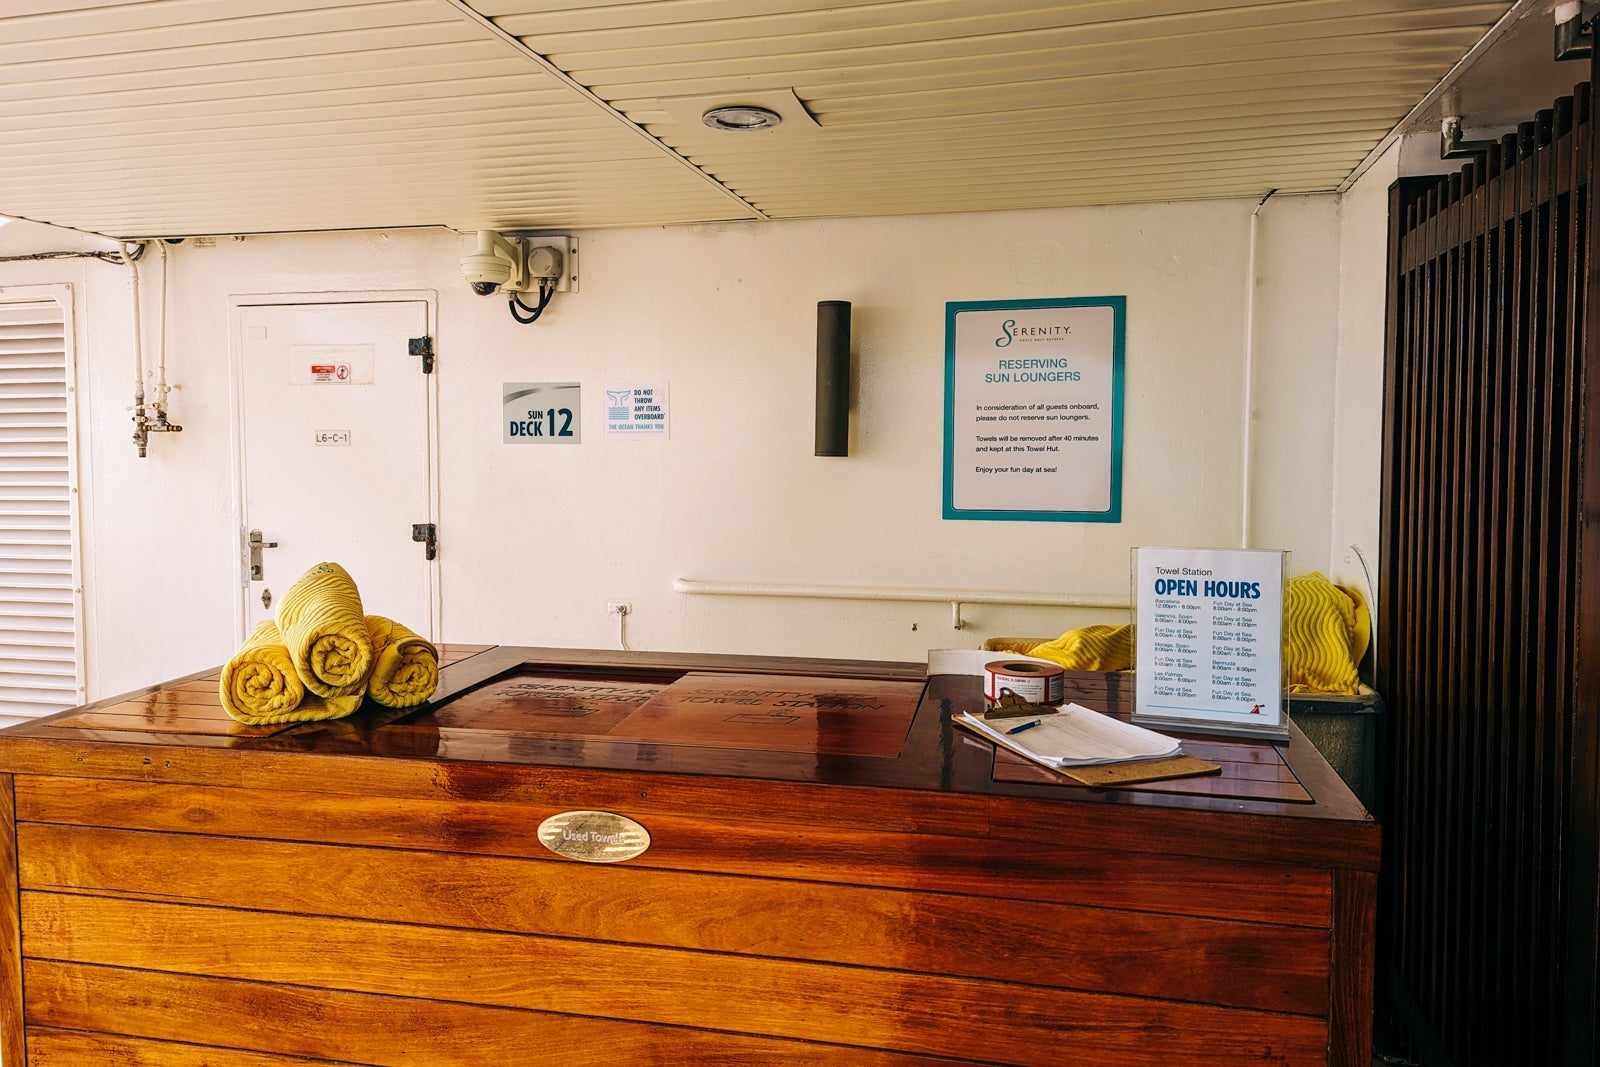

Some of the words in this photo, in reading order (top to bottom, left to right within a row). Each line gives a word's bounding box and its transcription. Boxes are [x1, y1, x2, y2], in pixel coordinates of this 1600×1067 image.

[995, 320, 1070, 347] SERENITY
[999, 358, 1067, 369] RESERVING
[986, 373, 1009, 383] SUN
[1014, 372, 1080, 382] LOUNGERS
[528, 410, 543, 419] SUN
[510, 421, 543, 436] DECK
[547, 408, 573, 436] 12
[316, 434, 346, 442] L6-C-1
[1182, 568, 1212, 576] Station
[1155, 579, 1197, 596] OPEN
[1204, 581, 1260, 599] HOURS
[563, 830, 589, 841] Used
[590, 831, 625, 844] Towels
